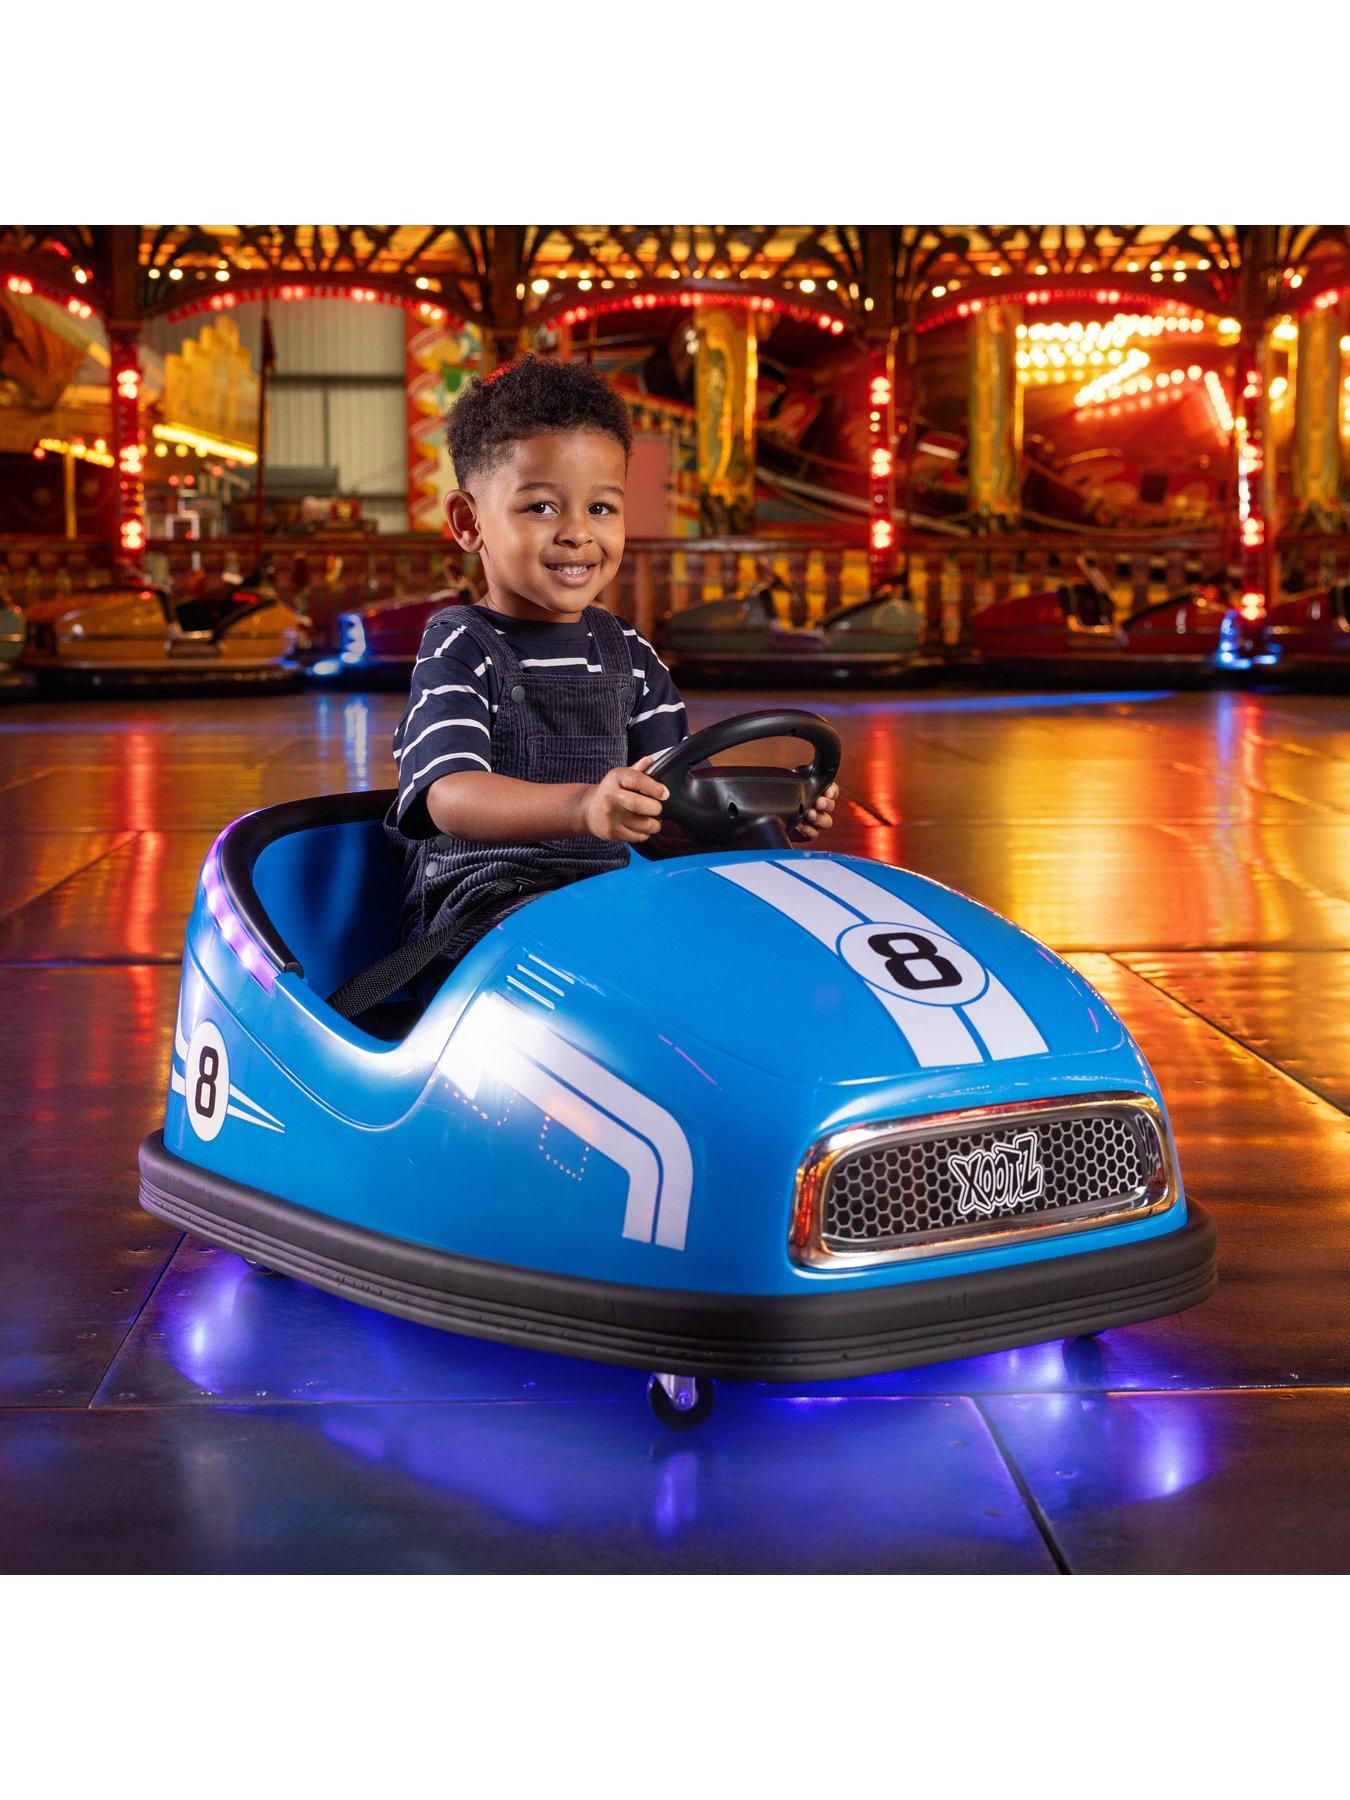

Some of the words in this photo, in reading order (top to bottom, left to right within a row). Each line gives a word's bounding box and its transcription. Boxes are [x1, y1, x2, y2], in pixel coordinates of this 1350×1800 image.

[868, 932, 962, 990] 8
[195, 1045, 219, 1118] 8
[948, 1132, 1043, 1214] XOOTZ
